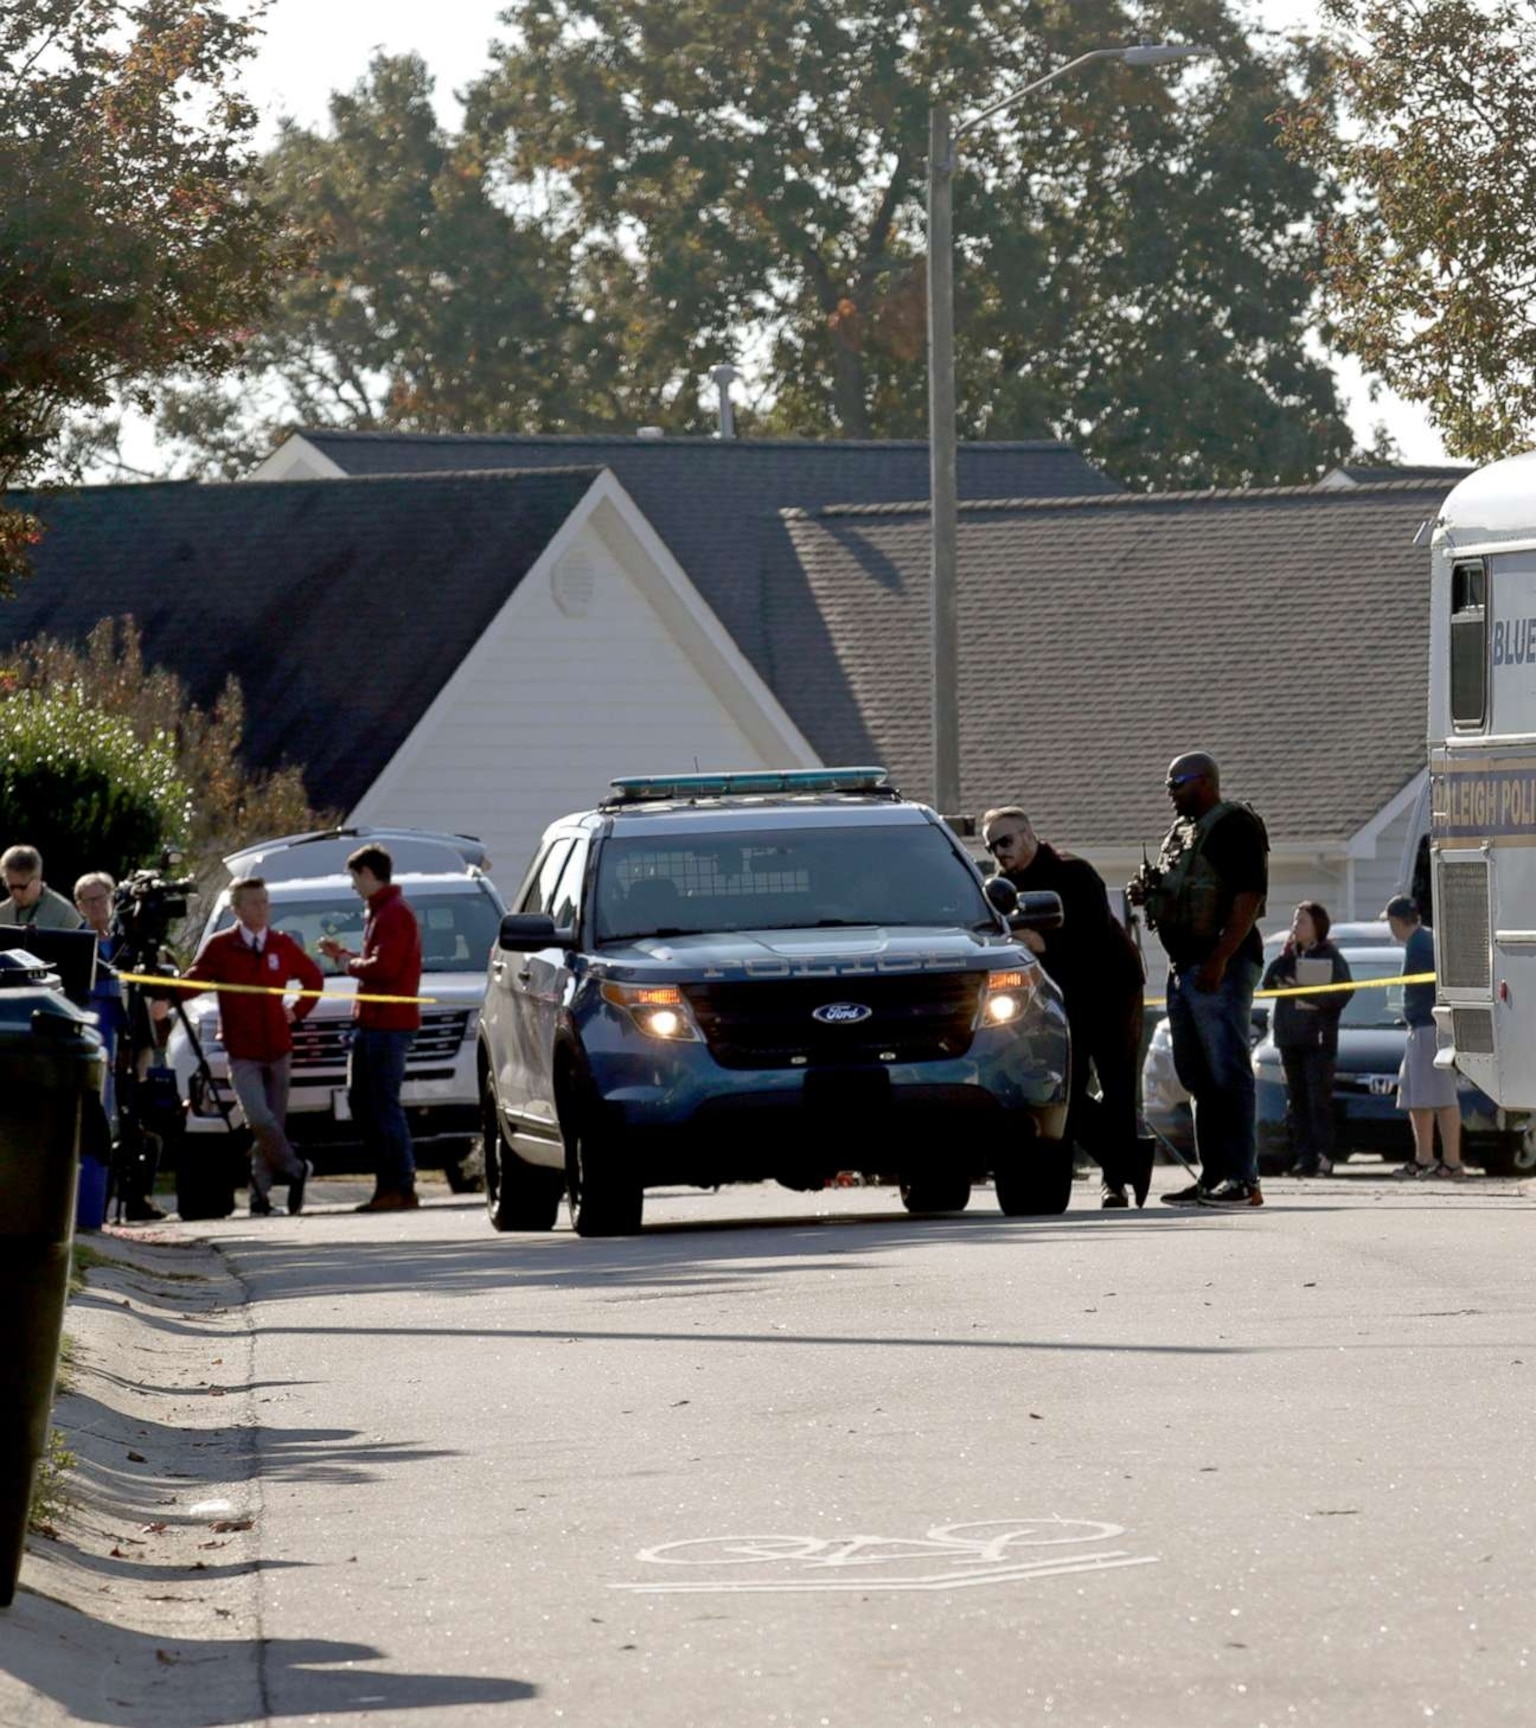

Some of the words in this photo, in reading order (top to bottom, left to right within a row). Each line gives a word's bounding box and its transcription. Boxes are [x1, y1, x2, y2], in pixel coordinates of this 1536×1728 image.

[1432, 780, 1497, 827] RALEIGH
[704, 951, 966, 977] POLICE
[826, 1005, 859, 1020] Ford
